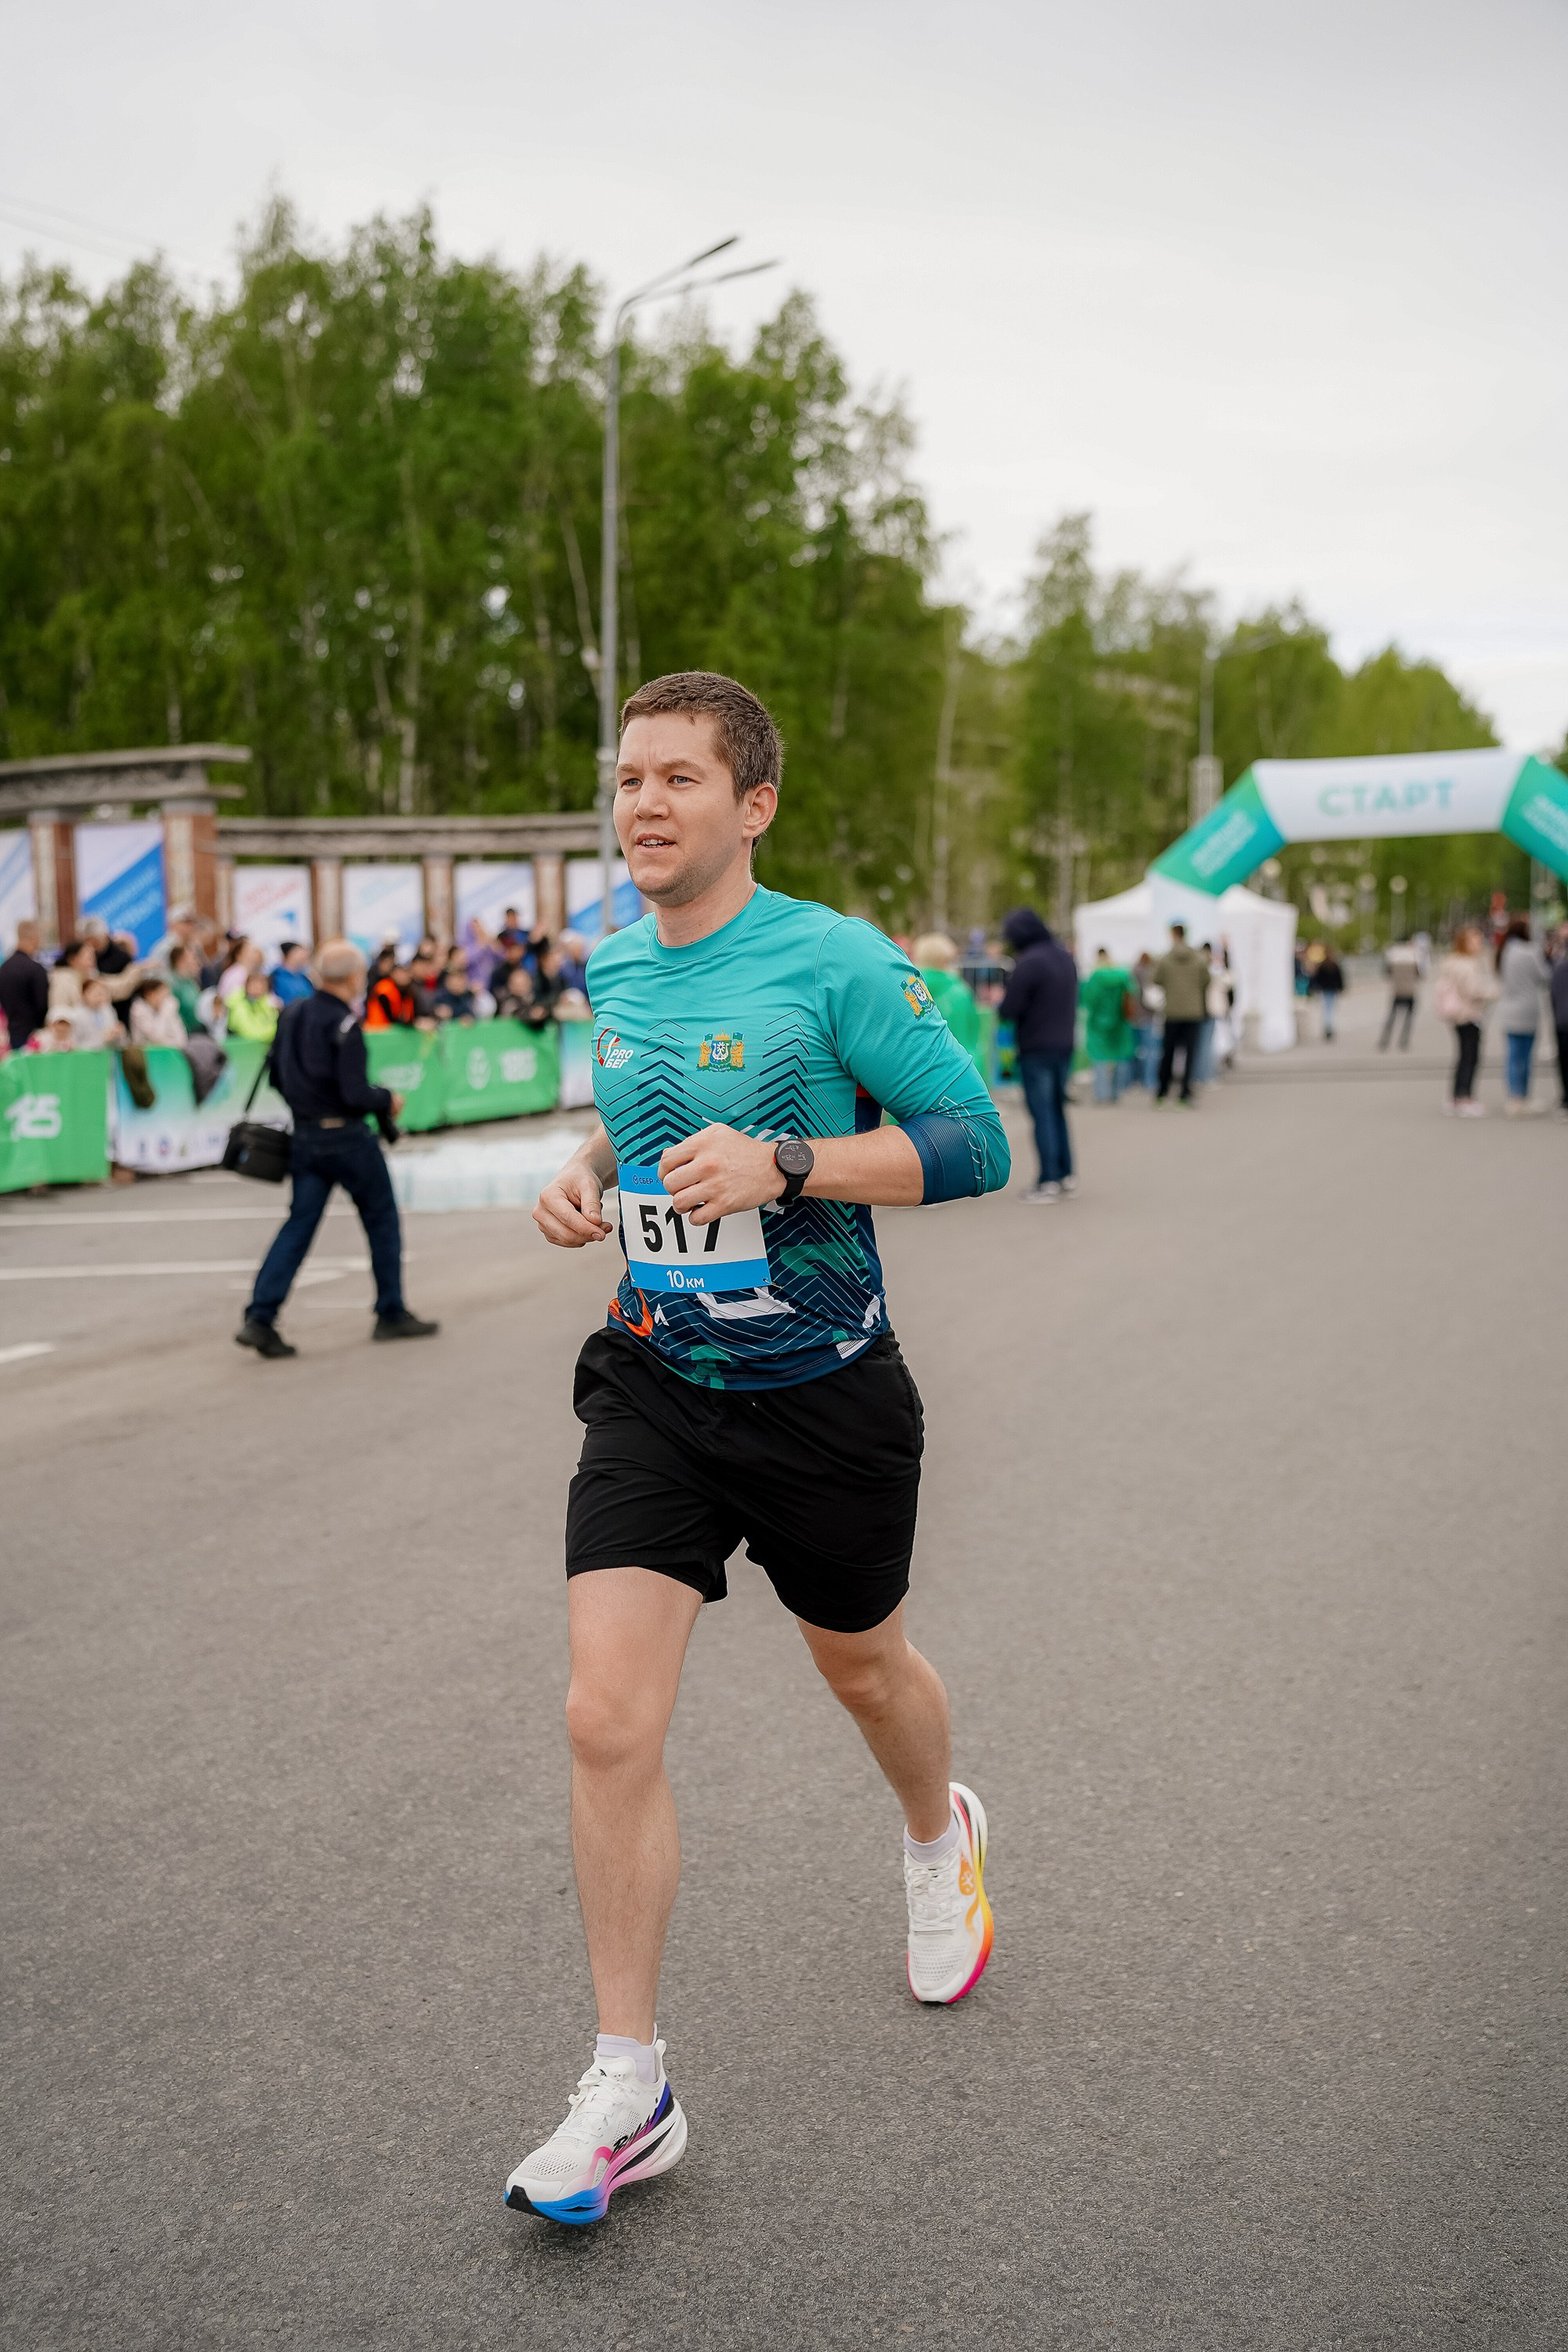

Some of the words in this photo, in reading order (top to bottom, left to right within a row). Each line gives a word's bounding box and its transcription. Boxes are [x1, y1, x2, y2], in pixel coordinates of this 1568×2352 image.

[1318, 779, 1457, 816] СТАРТ
[610, 1048, 634, 1059] PRO
[604, 1058, 629, 1069] БЕГ
